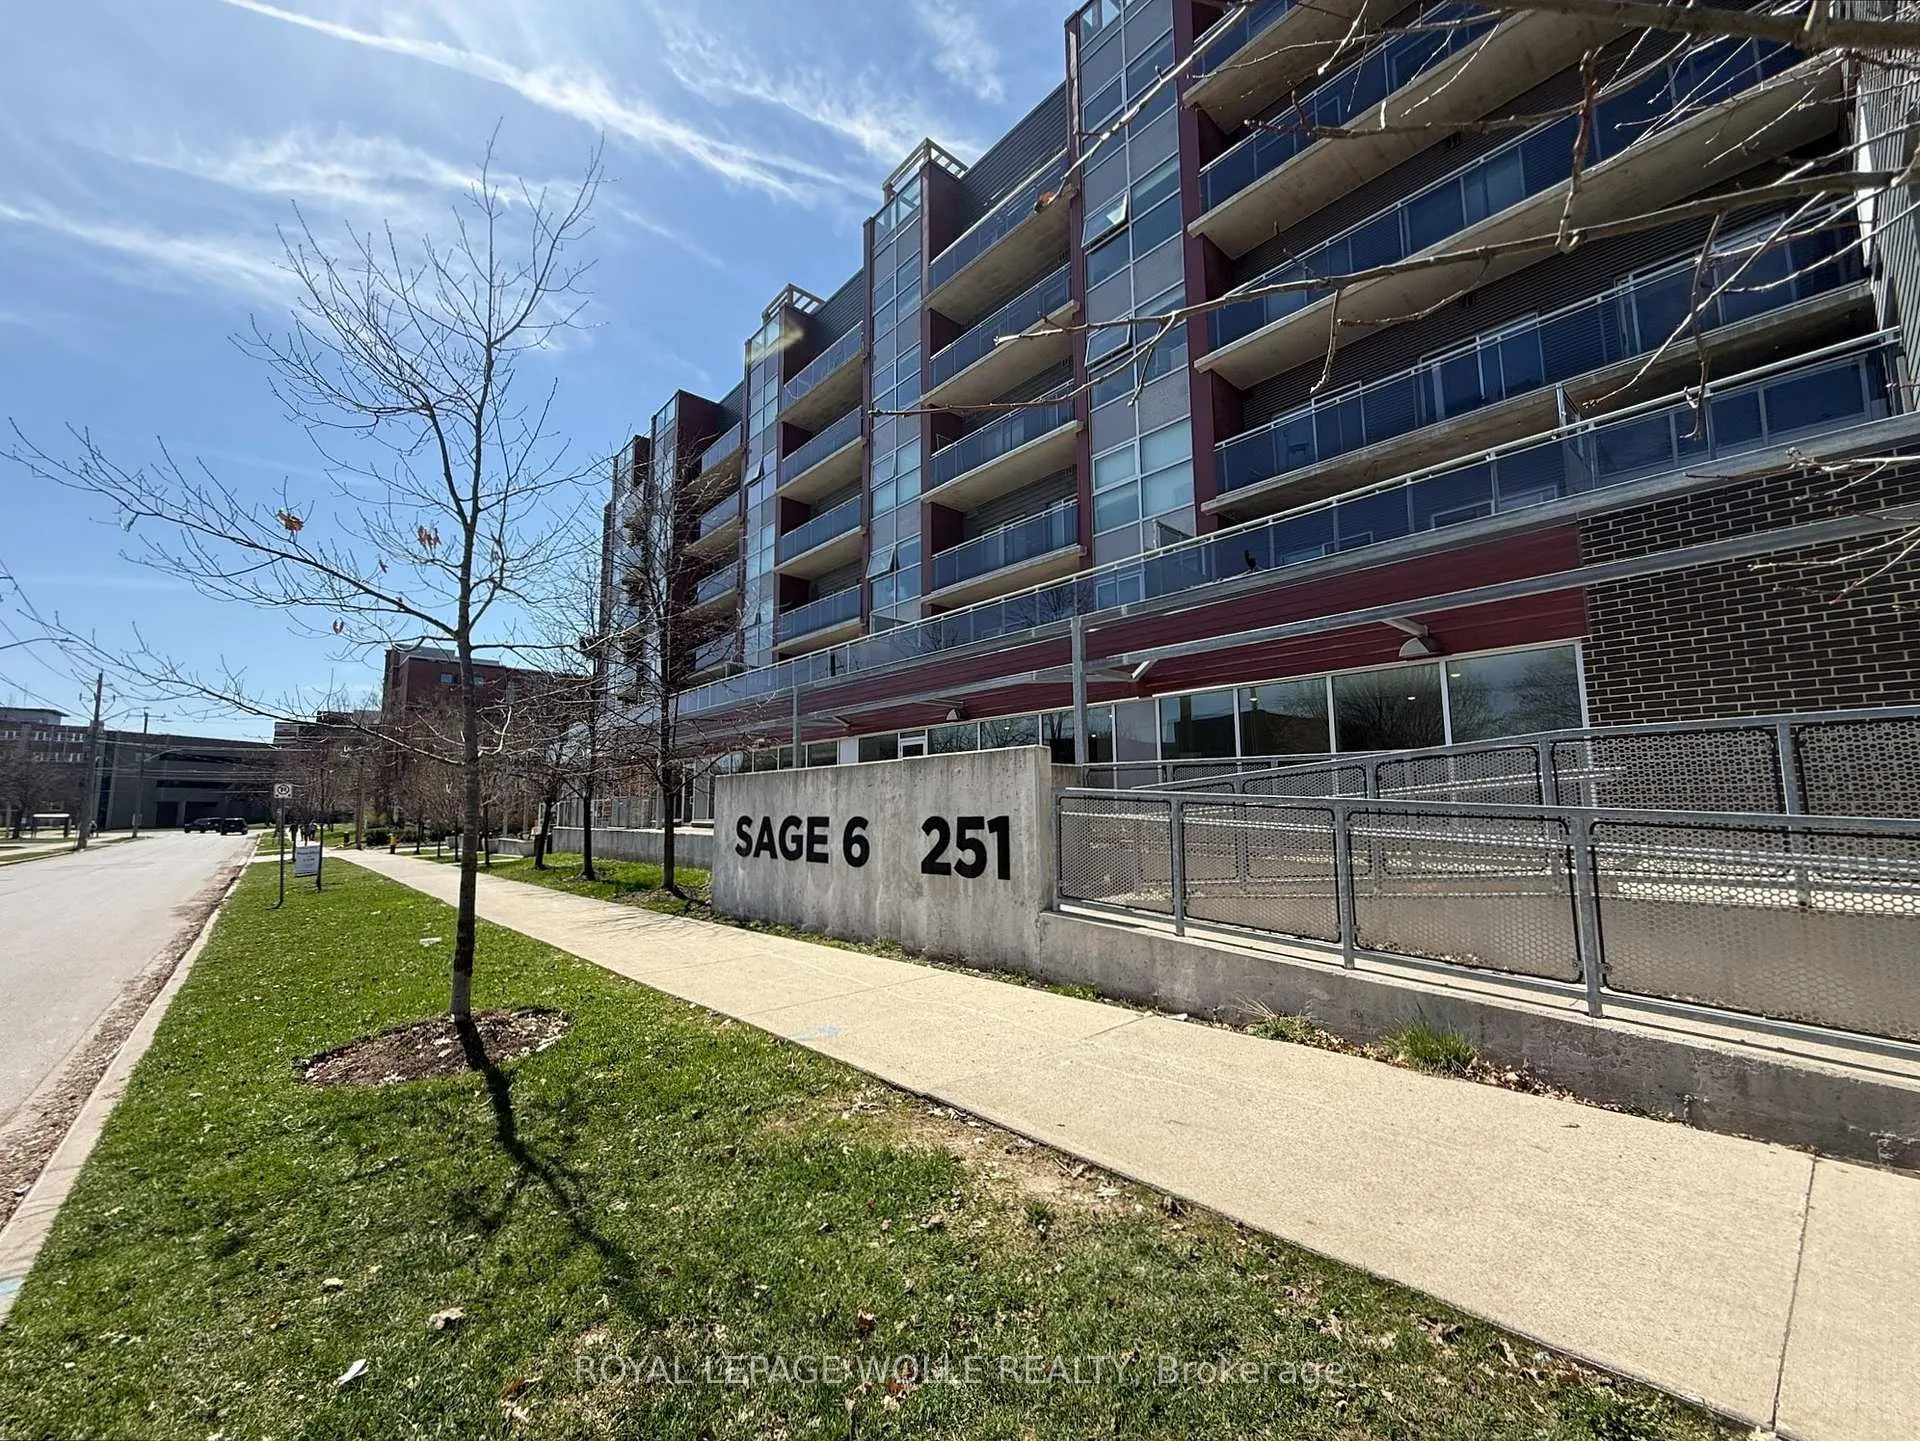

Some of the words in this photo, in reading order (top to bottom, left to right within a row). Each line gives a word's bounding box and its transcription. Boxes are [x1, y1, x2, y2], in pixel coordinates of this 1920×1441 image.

[735, 815, 830, 864] SAGE
[843, 816, 871, 868] 6
[921, 815, 1011, 881] 251
